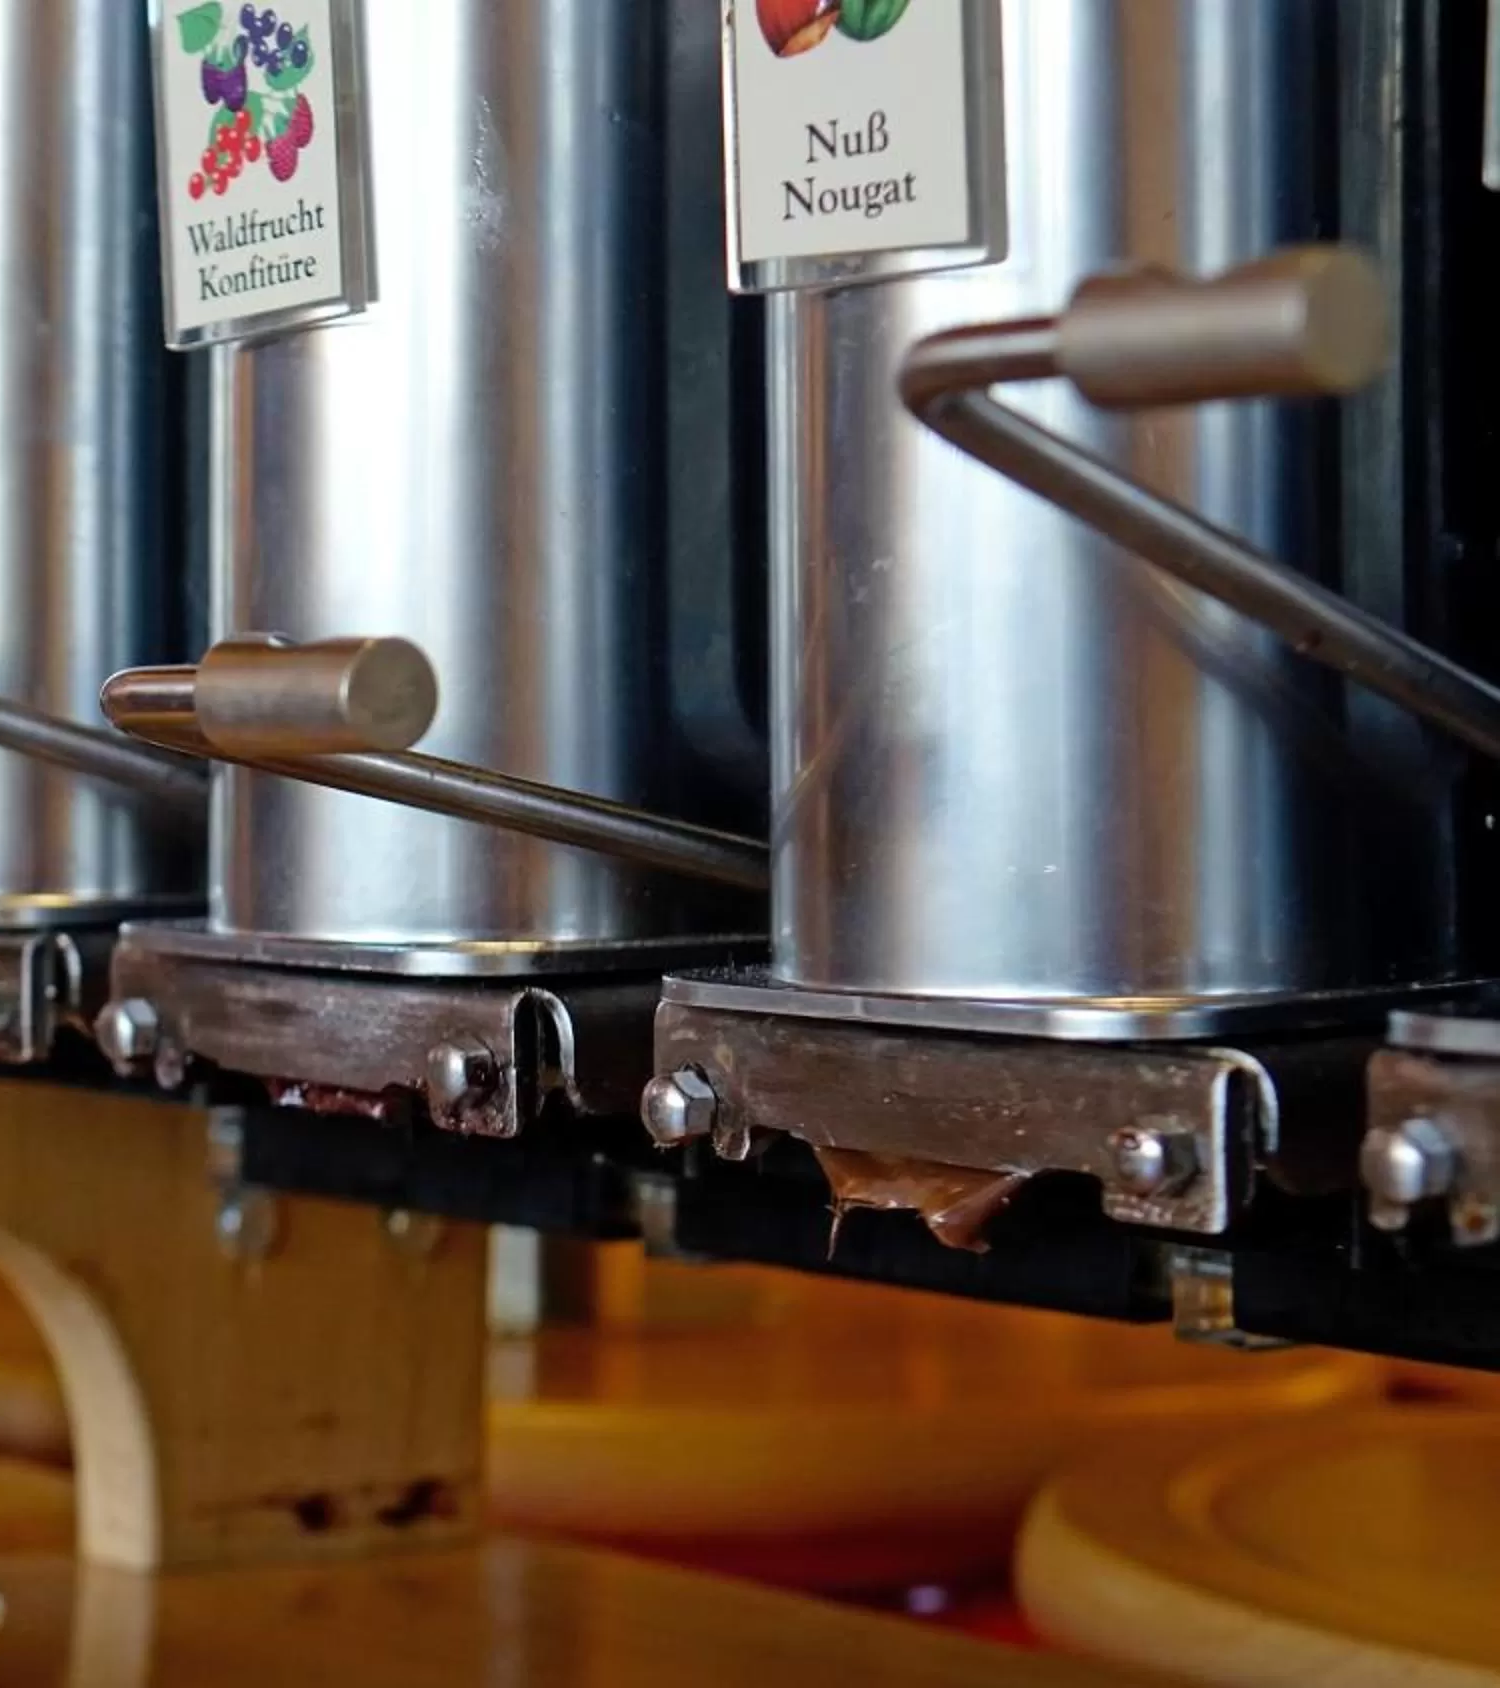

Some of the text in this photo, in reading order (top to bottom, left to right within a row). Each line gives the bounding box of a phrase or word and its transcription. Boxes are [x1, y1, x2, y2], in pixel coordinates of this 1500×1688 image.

[804, 109, 890, 164] Nuß
[780, 172, 917, 219] Nougat
[187, 198, 325, 256] Waldfrucht
[198, 254, 318, 300] Konfitüre
